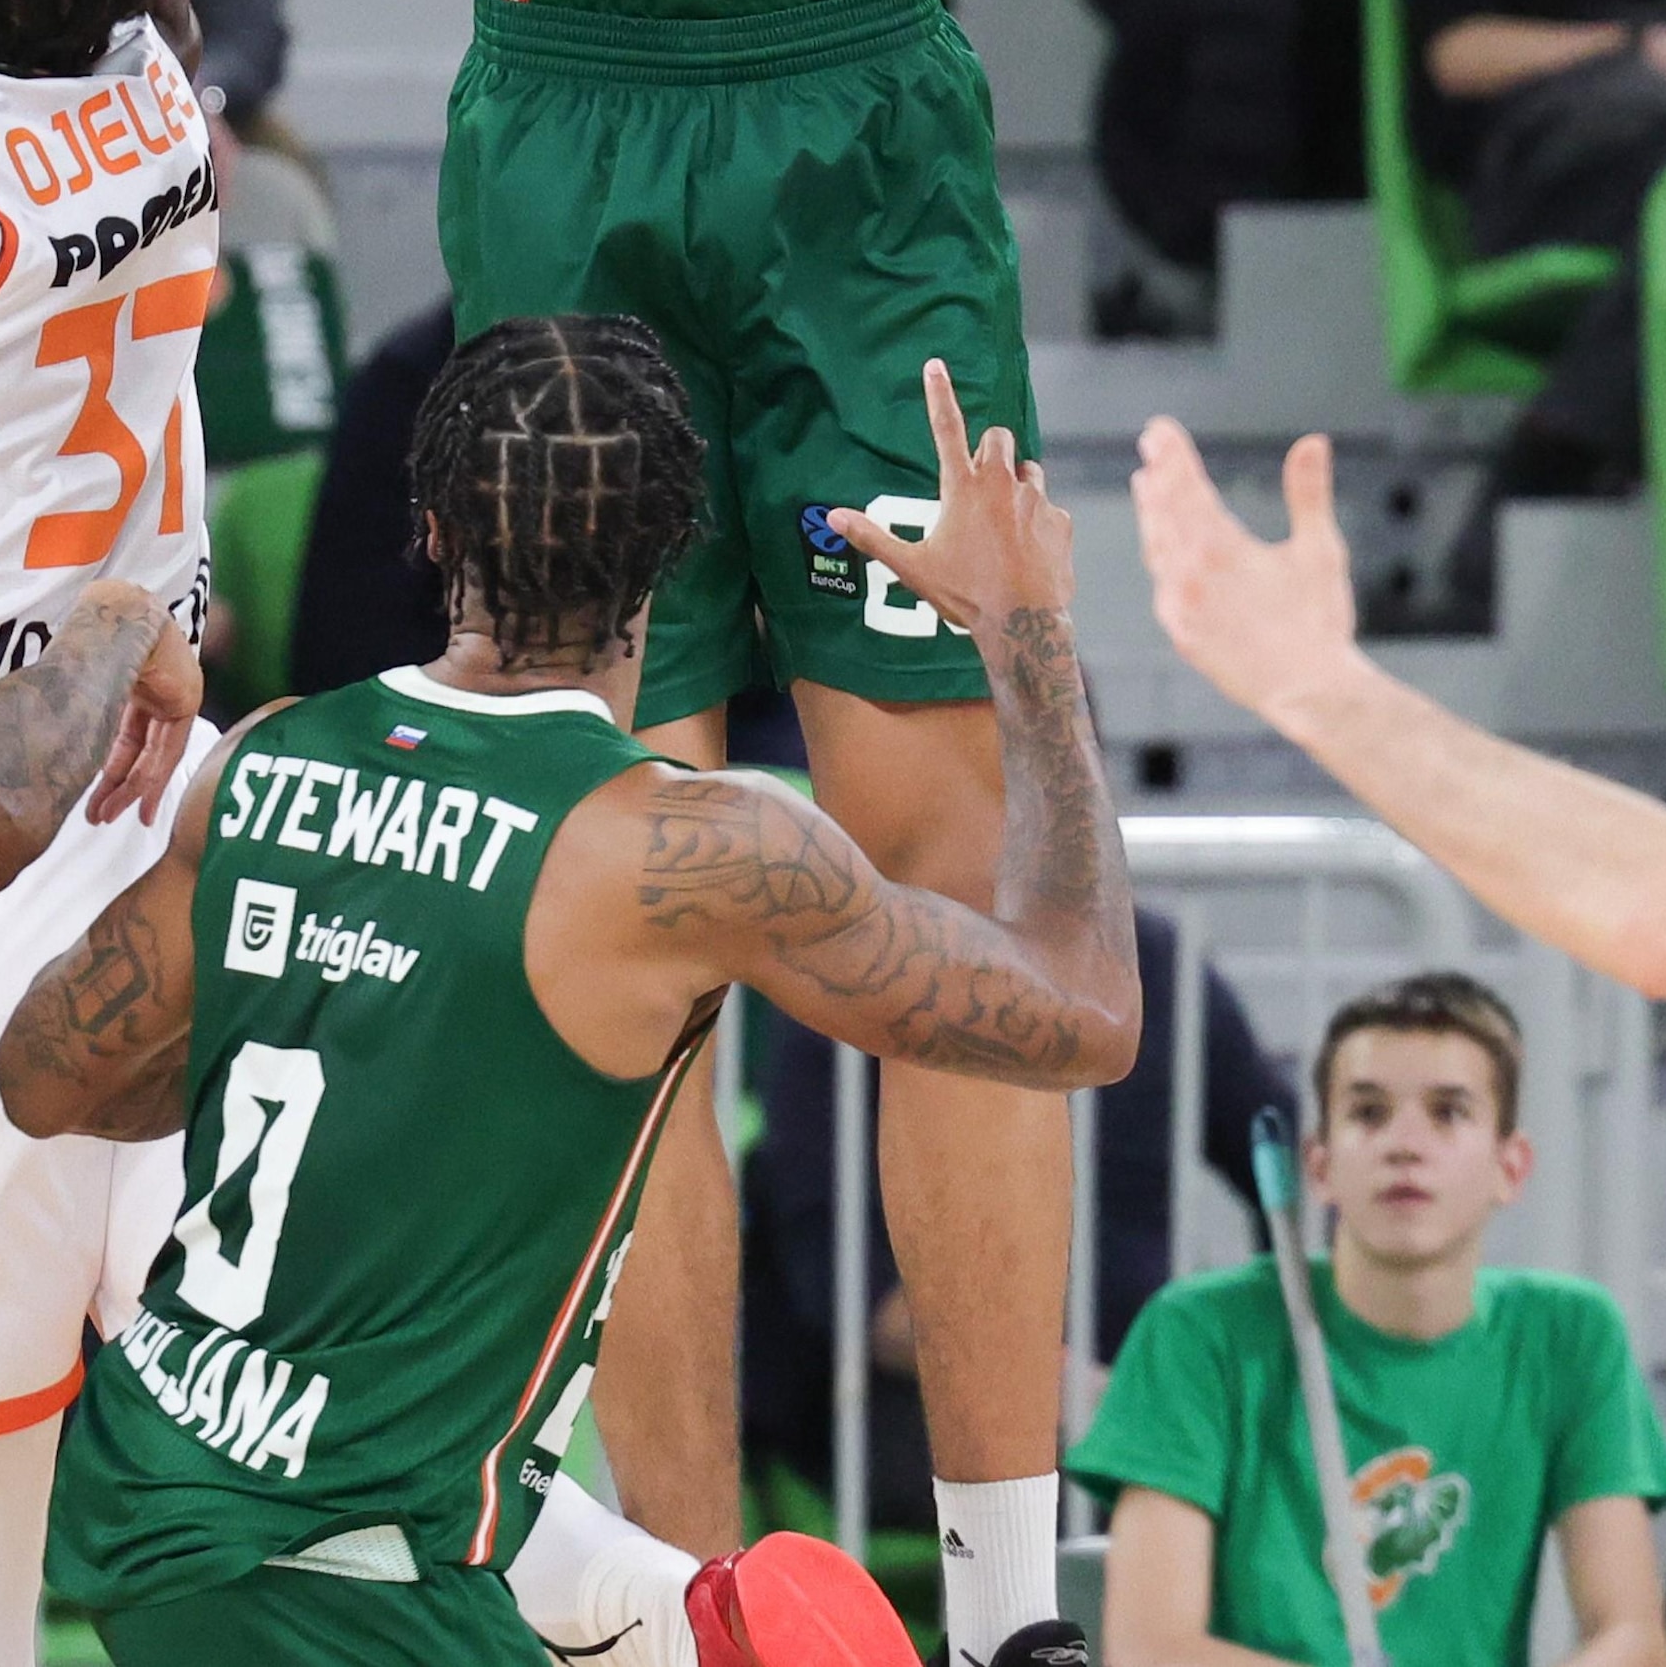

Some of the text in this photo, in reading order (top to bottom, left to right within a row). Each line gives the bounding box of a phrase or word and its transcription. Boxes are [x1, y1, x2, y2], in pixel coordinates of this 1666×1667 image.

[24, 268, 216, 570] 37
[810, 572, 857, 598] EuroCup
[864, 494, 973, 638] 2
[219, 751, 540, 893] STEWART
[294, 912, 421, 984] triglav
[173, 1040, 327, 1332] 0
